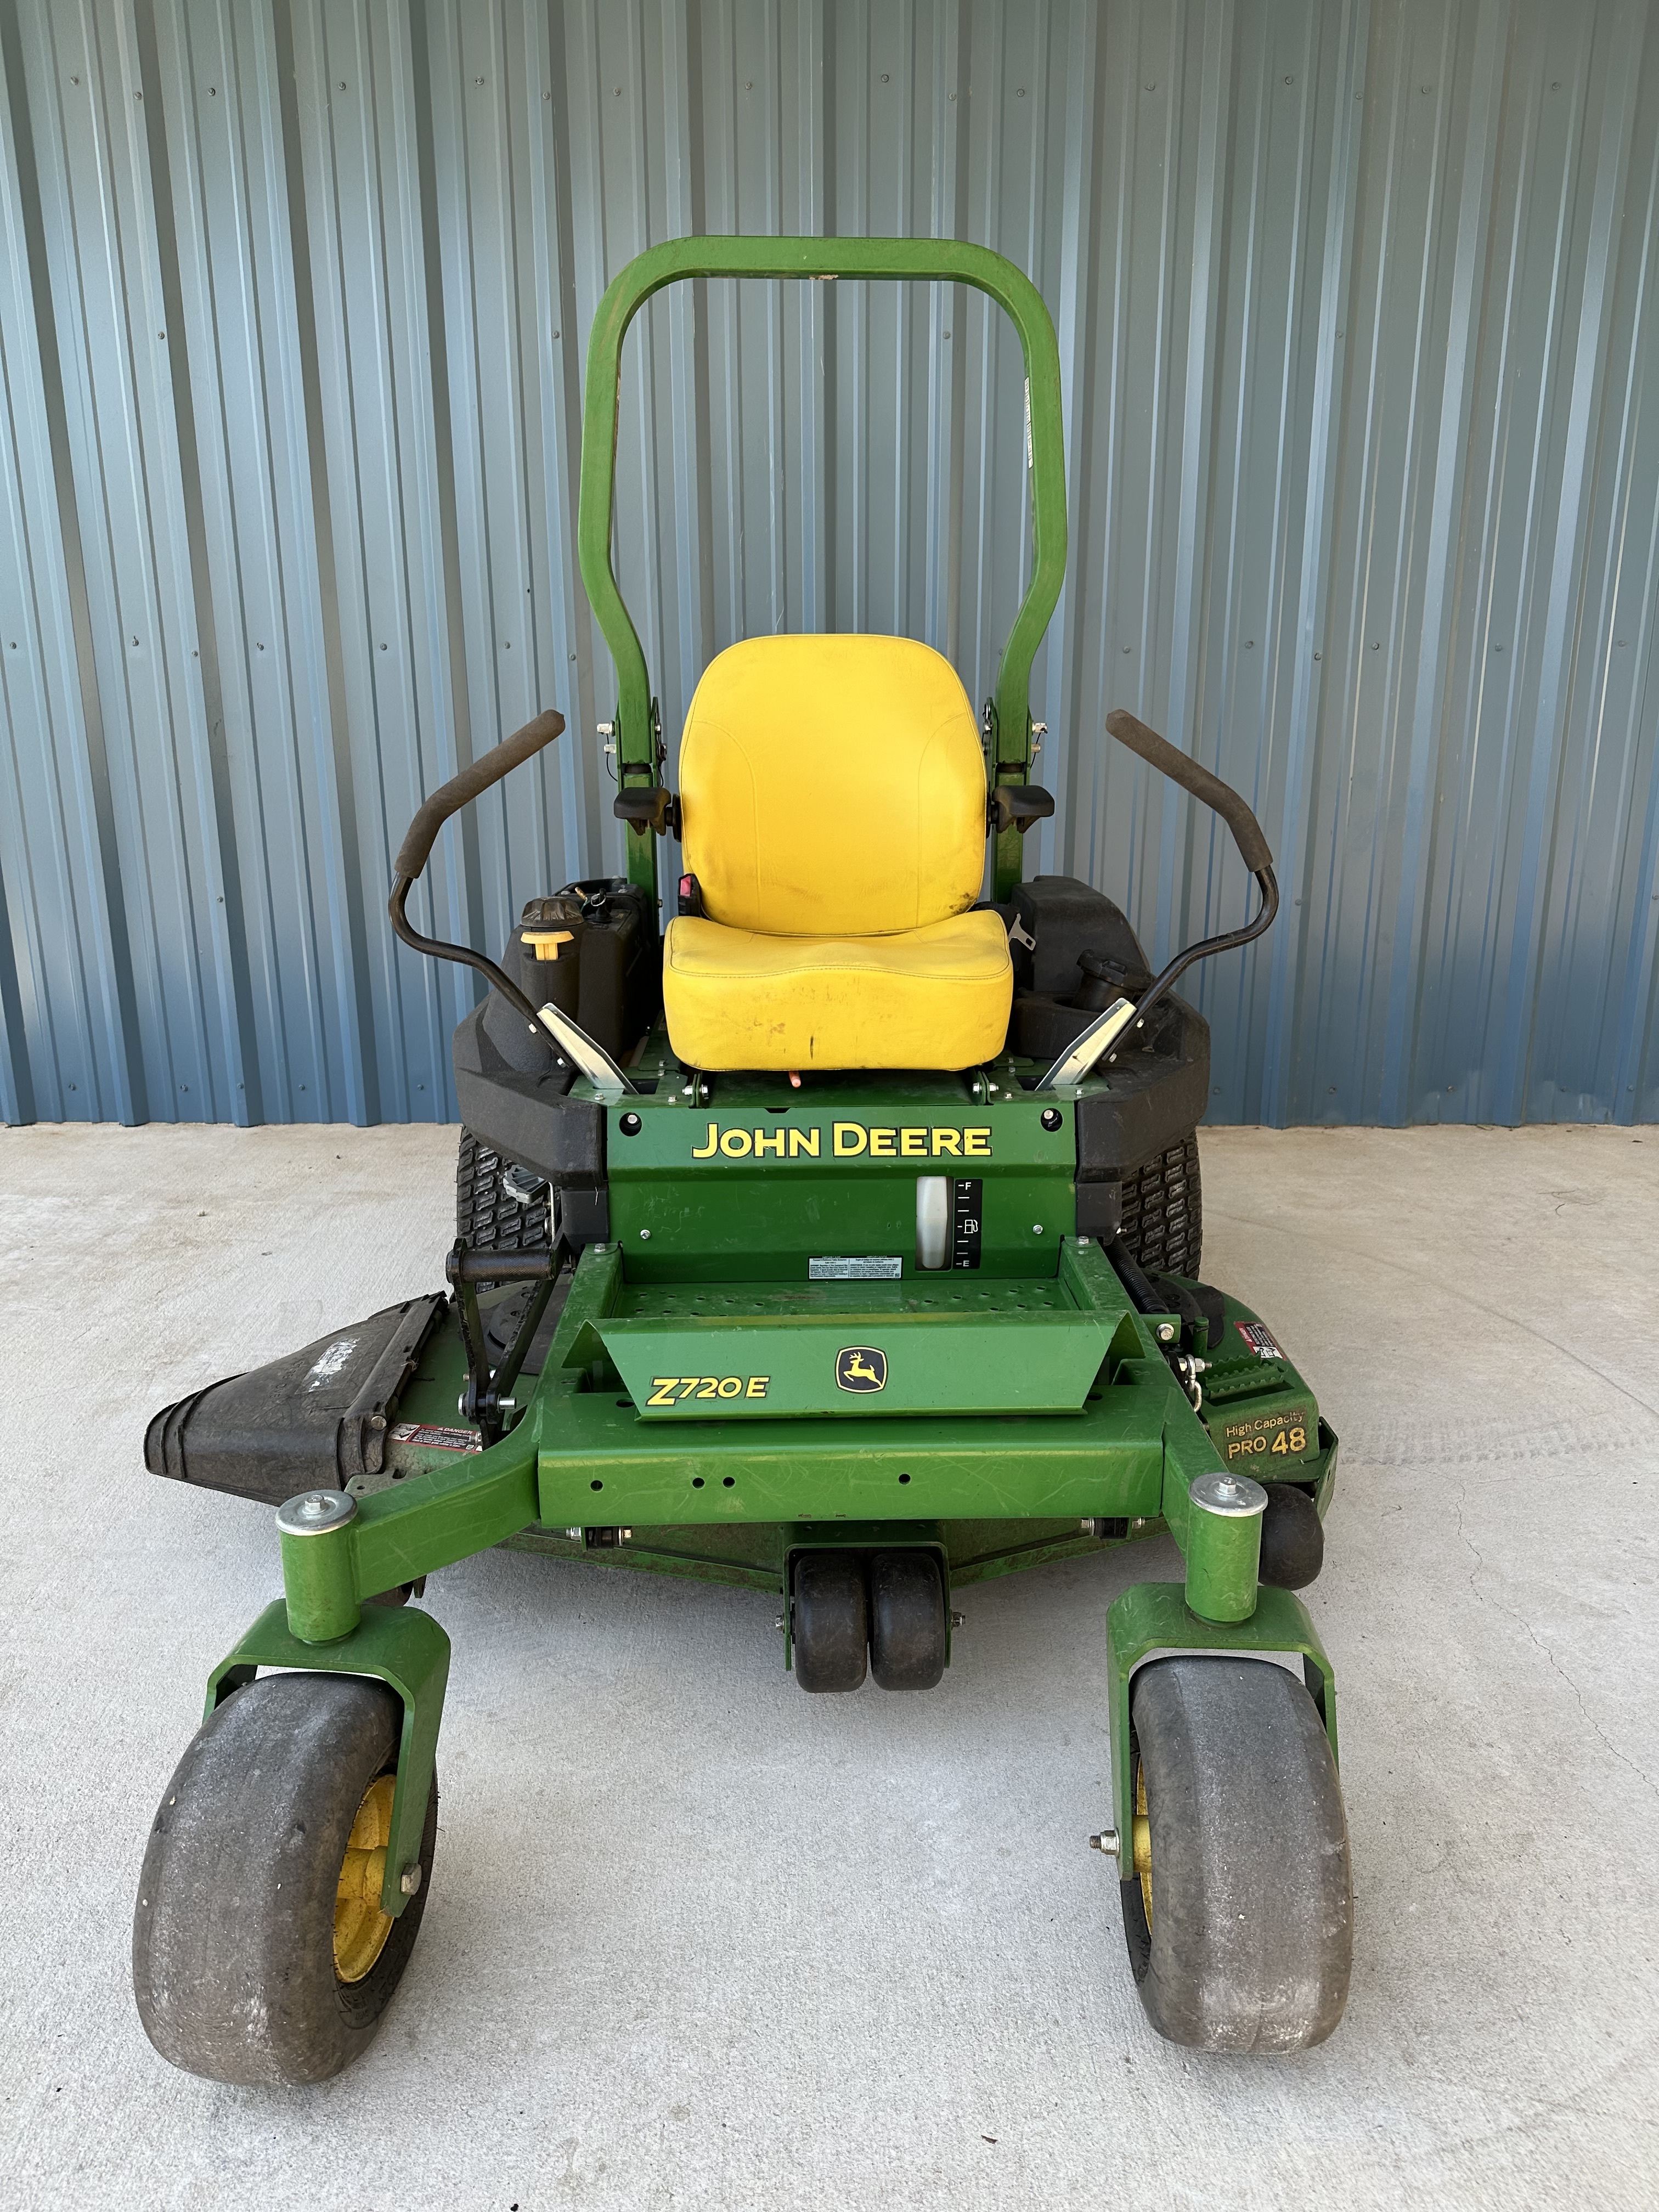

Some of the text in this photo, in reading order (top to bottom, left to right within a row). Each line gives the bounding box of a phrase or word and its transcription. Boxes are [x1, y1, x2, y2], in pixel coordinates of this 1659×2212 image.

[691, 1121, 992, 1159] JOHN DEERE
[1226, 1412, 1305, 1437] High Capacity
[1228, 1427, 1306, 1459] PRO 48
